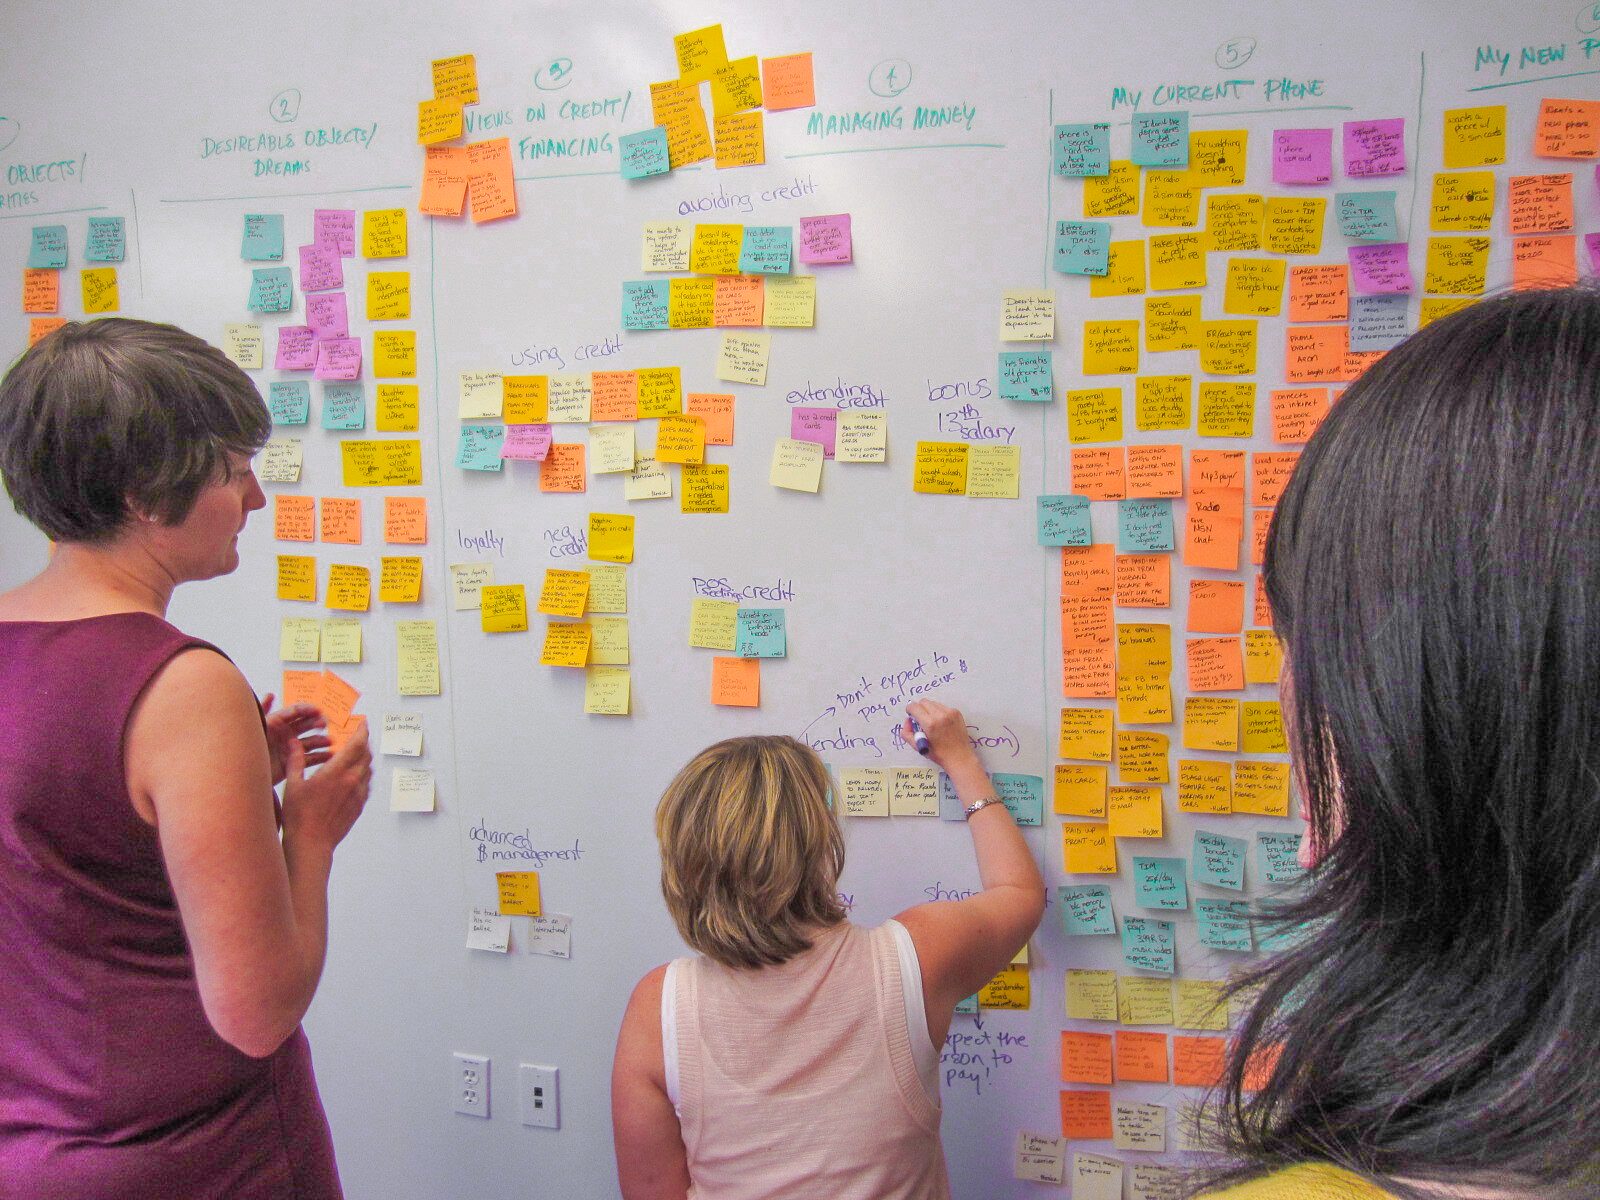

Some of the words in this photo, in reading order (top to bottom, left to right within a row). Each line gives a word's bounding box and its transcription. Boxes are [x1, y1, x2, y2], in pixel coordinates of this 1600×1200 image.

[1226, 43, 1240, 63] 5
[1520, 43, 1566, 69] NEW
[550, 62, 563, 81] 3
[1154, 79, 1254, 105] CURRENT
[1264, 78, 1324, 101] PHONE
[279, 99, 290, 117] 2
[465, 106, 514, 133] VIEWS
[527, 100, 547, 122] ON
[807, 107, 903, 136] MANAGING
[913, 101, 977, 132] MONEY
[201, 133, 295, 160] DESIREABLE
[519, 133, 614, 161] FINANCING
[254, 159, 311, 177] DREAMS
[679, 184, 753, 216] avoiding
[761, 176, 818, 202] credit
[511, 344, 565, 369] using
[574, 334, 623, 361] credit
[785, 377, 875, 406] extending
[837, 390, 890, 409] credit
[928, 378, 992, 401] bonus
[961, 421, 1015, 444] salary
[458, 529, 504, 557] loyalty
[550, 529, 587, 557] credit
[743, 578, 795, 602] credit
[880, 659, 926, 692] expect
[933, 652, 948, 668] to
[858, 703, 890, 722] pay
[910, 672, 955, 696] receive
[469, 818, 532, 850] advanced
[477, 843, 488, 863] $
[492, 839, 585, 868] management
[946, 1031, 991, 1054] xpect
[997, 1032, 1028, 1047] the
[940, 1053, 984, 1065] rson
[992, 1049, 1012, 1068] to
[947, 1067, 992, 1095] pay!
